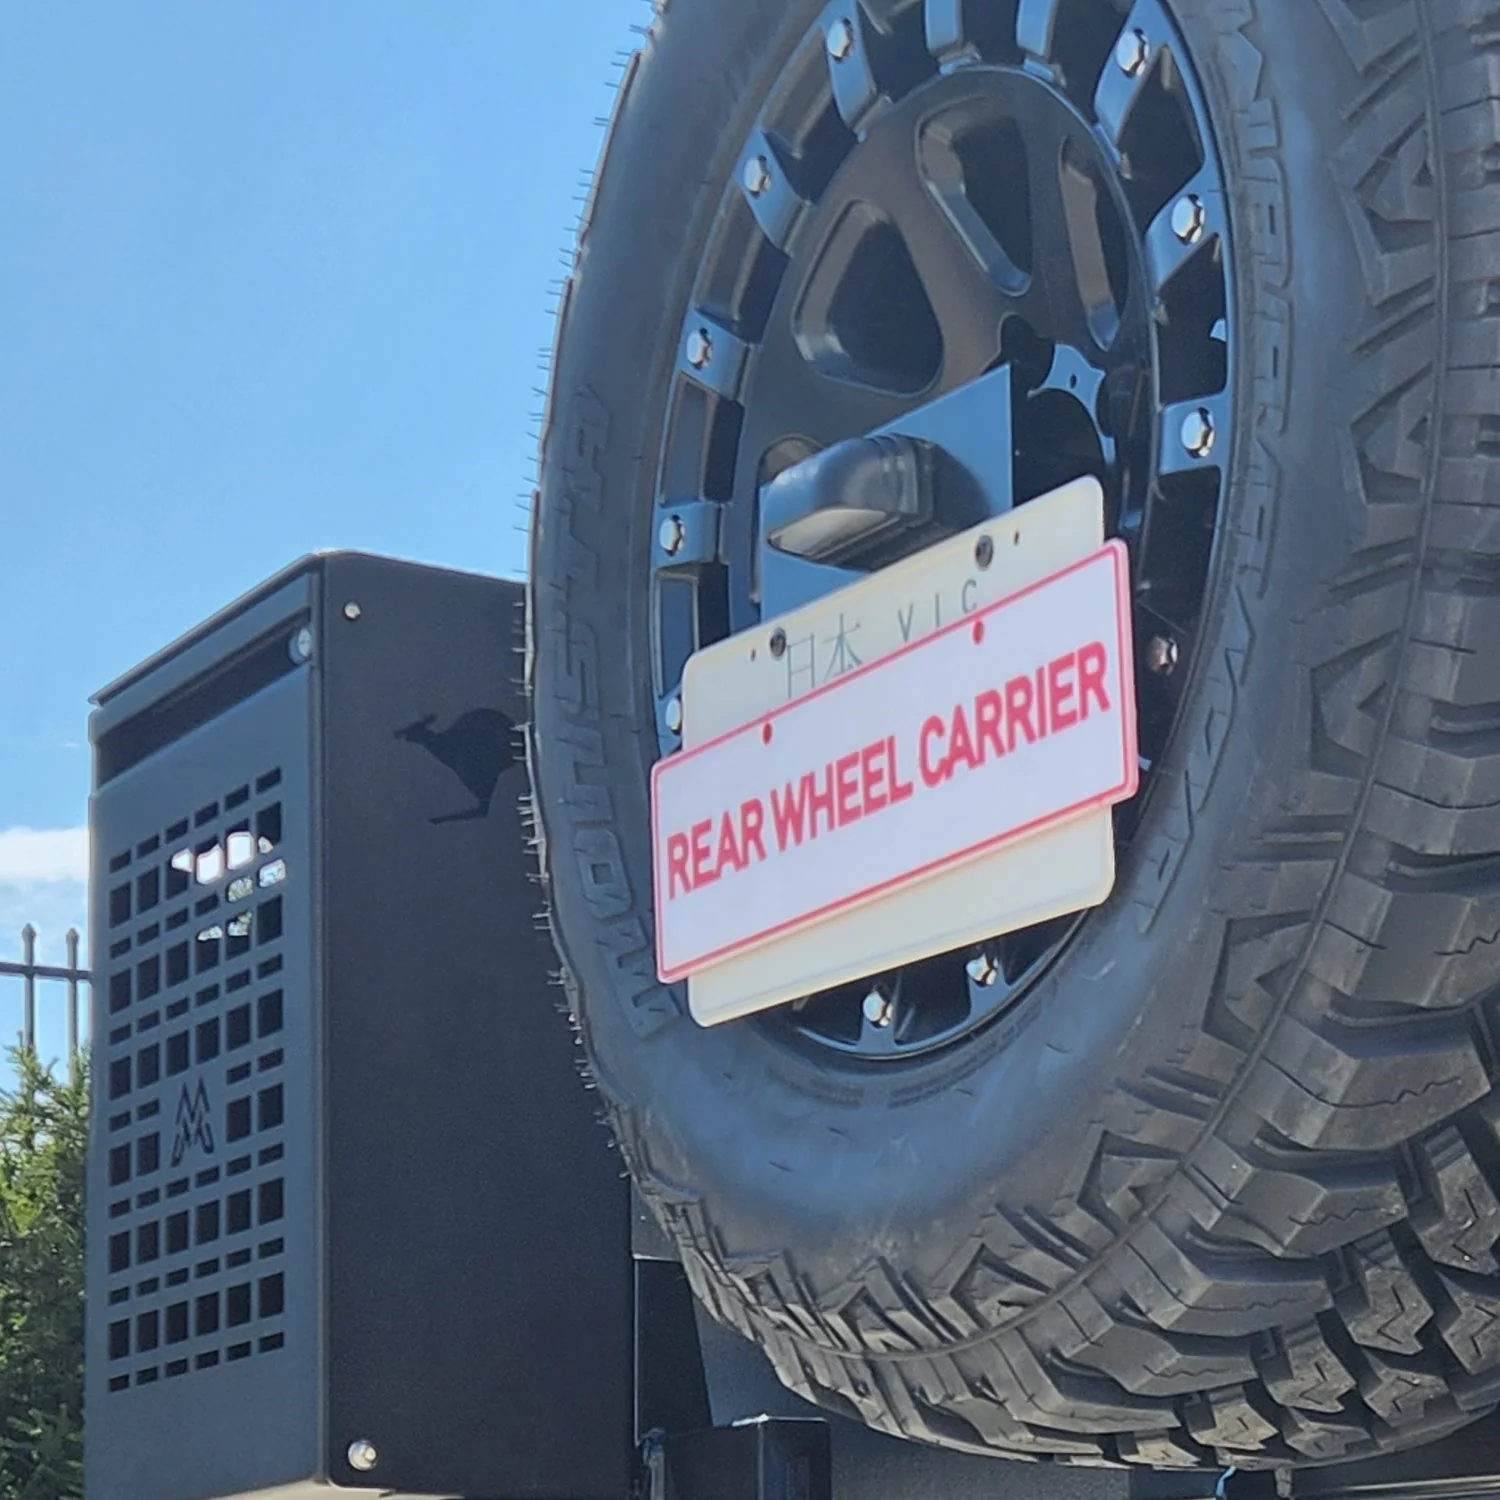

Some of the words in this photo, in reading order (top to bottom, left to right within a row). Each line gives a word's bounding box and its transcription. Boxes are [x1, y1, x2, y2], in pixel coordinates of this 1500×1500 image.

[896, 578, 977, 645] VIC
[667, 797, 767, 899] REAR
[769, 736, 913, 853] WHEEL
[919, 641, 1110, 788] CARRIER
